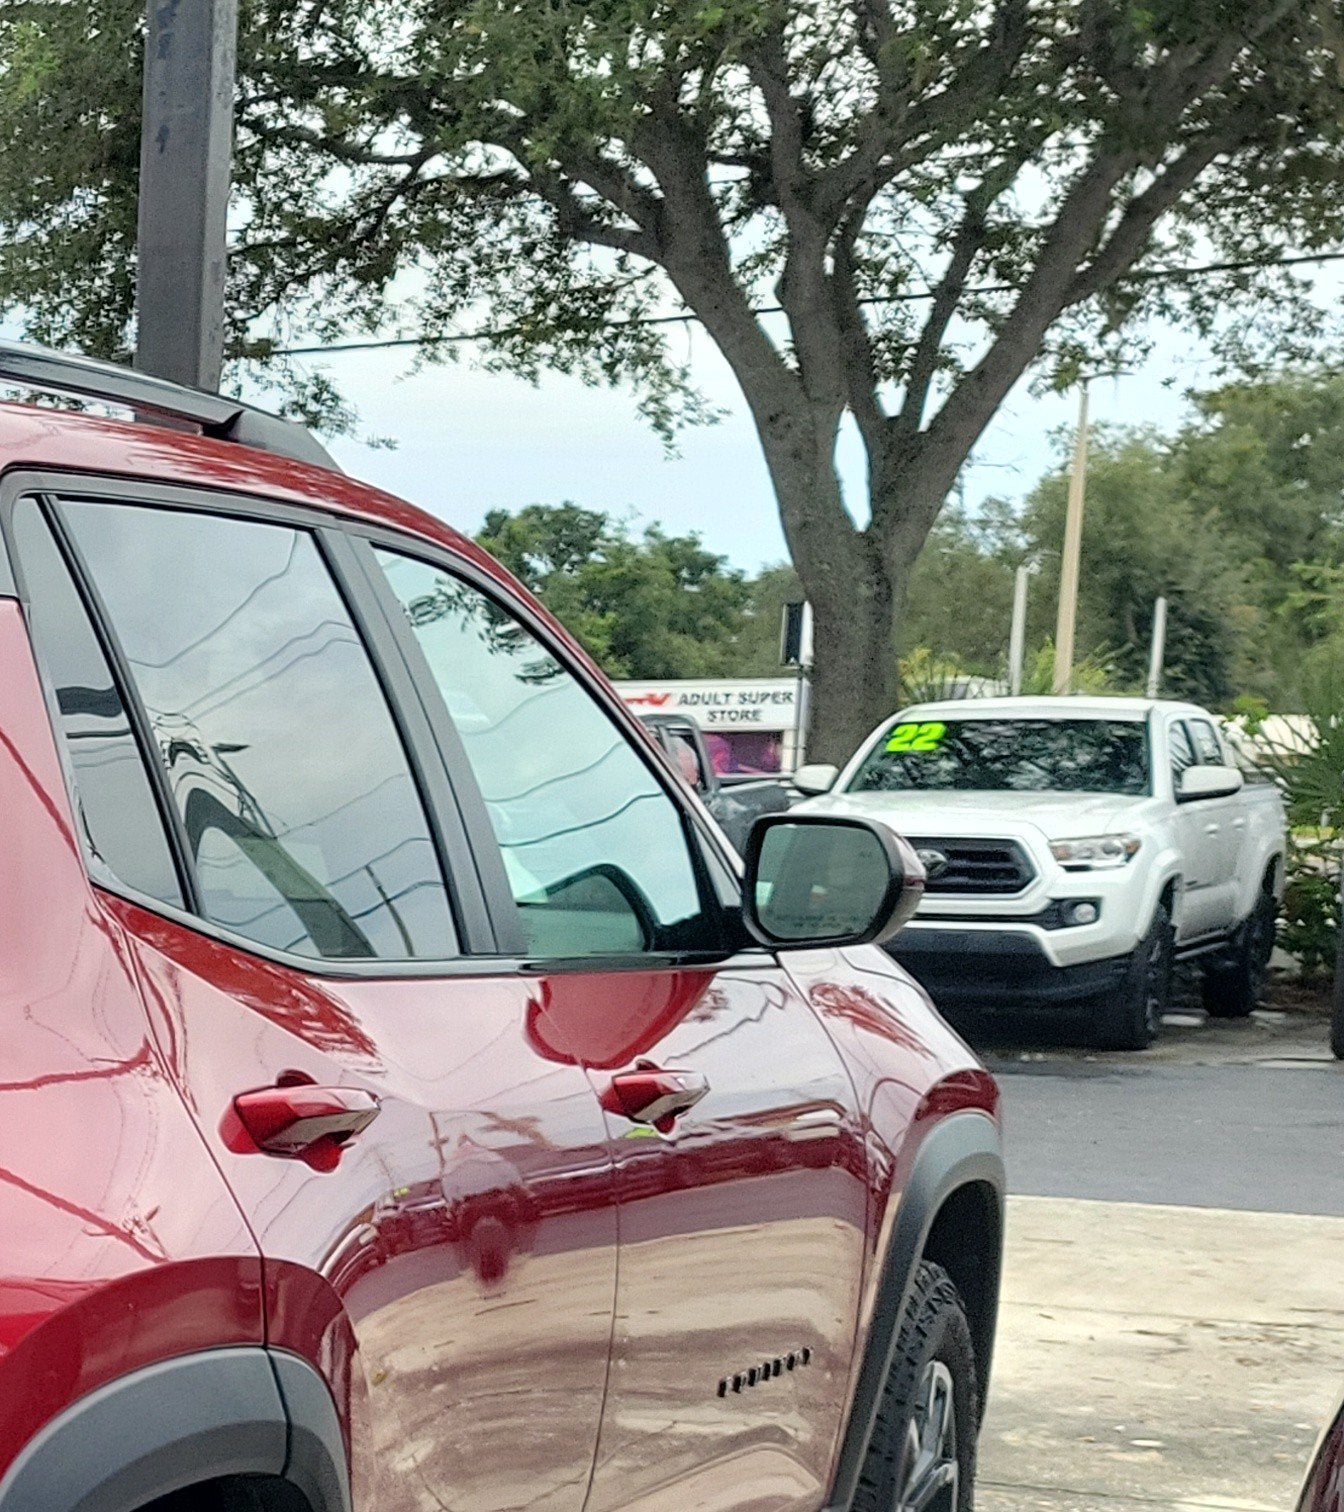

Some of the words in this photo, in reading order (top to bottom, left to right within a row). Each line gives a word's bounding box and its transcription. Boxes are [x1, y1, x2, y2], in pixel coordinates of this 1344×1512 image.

[678, 692, 731, 707] ADULT
[738, 690, 794, 706] SUPER
[707, 708, 763, 724] STORE
[885, 722, 946, 752] 22
